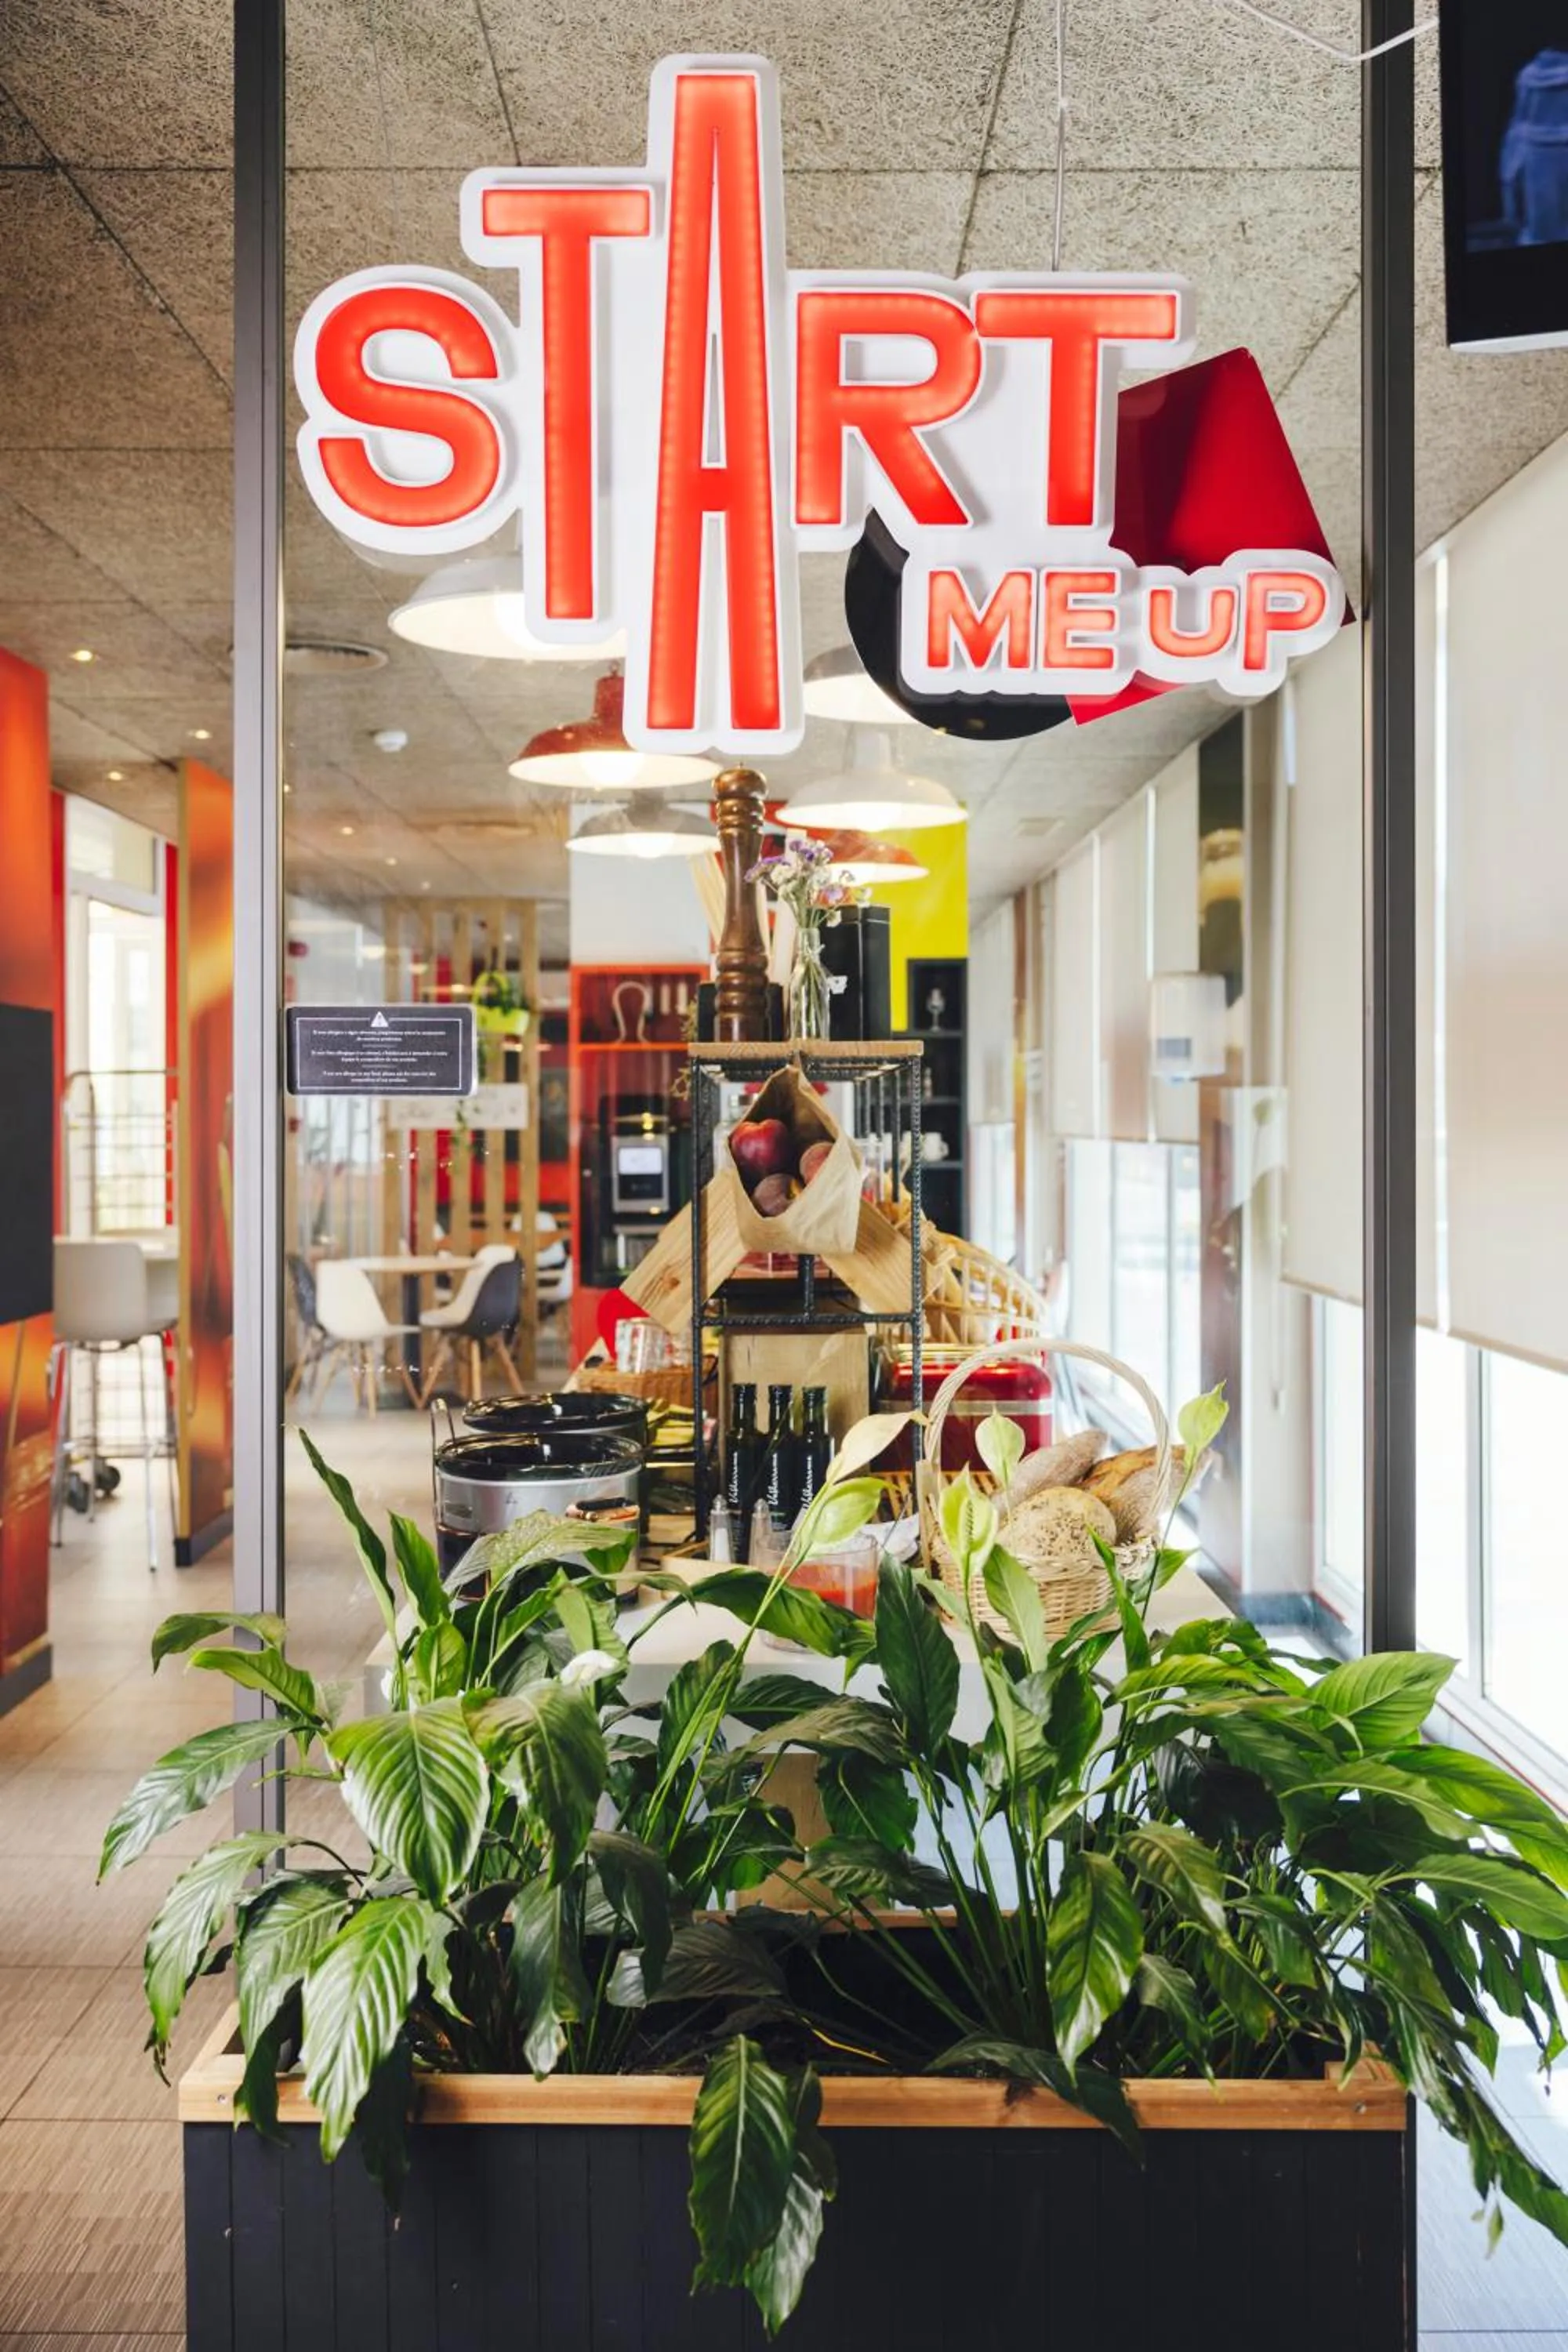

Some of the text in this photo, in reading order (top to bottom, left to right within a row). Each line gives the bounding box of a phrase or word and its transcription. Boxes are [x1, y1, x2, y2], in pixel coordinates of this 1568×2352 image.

[313, 74, 1178, 731] START
[927, 568, 1327, 671] ME UP
